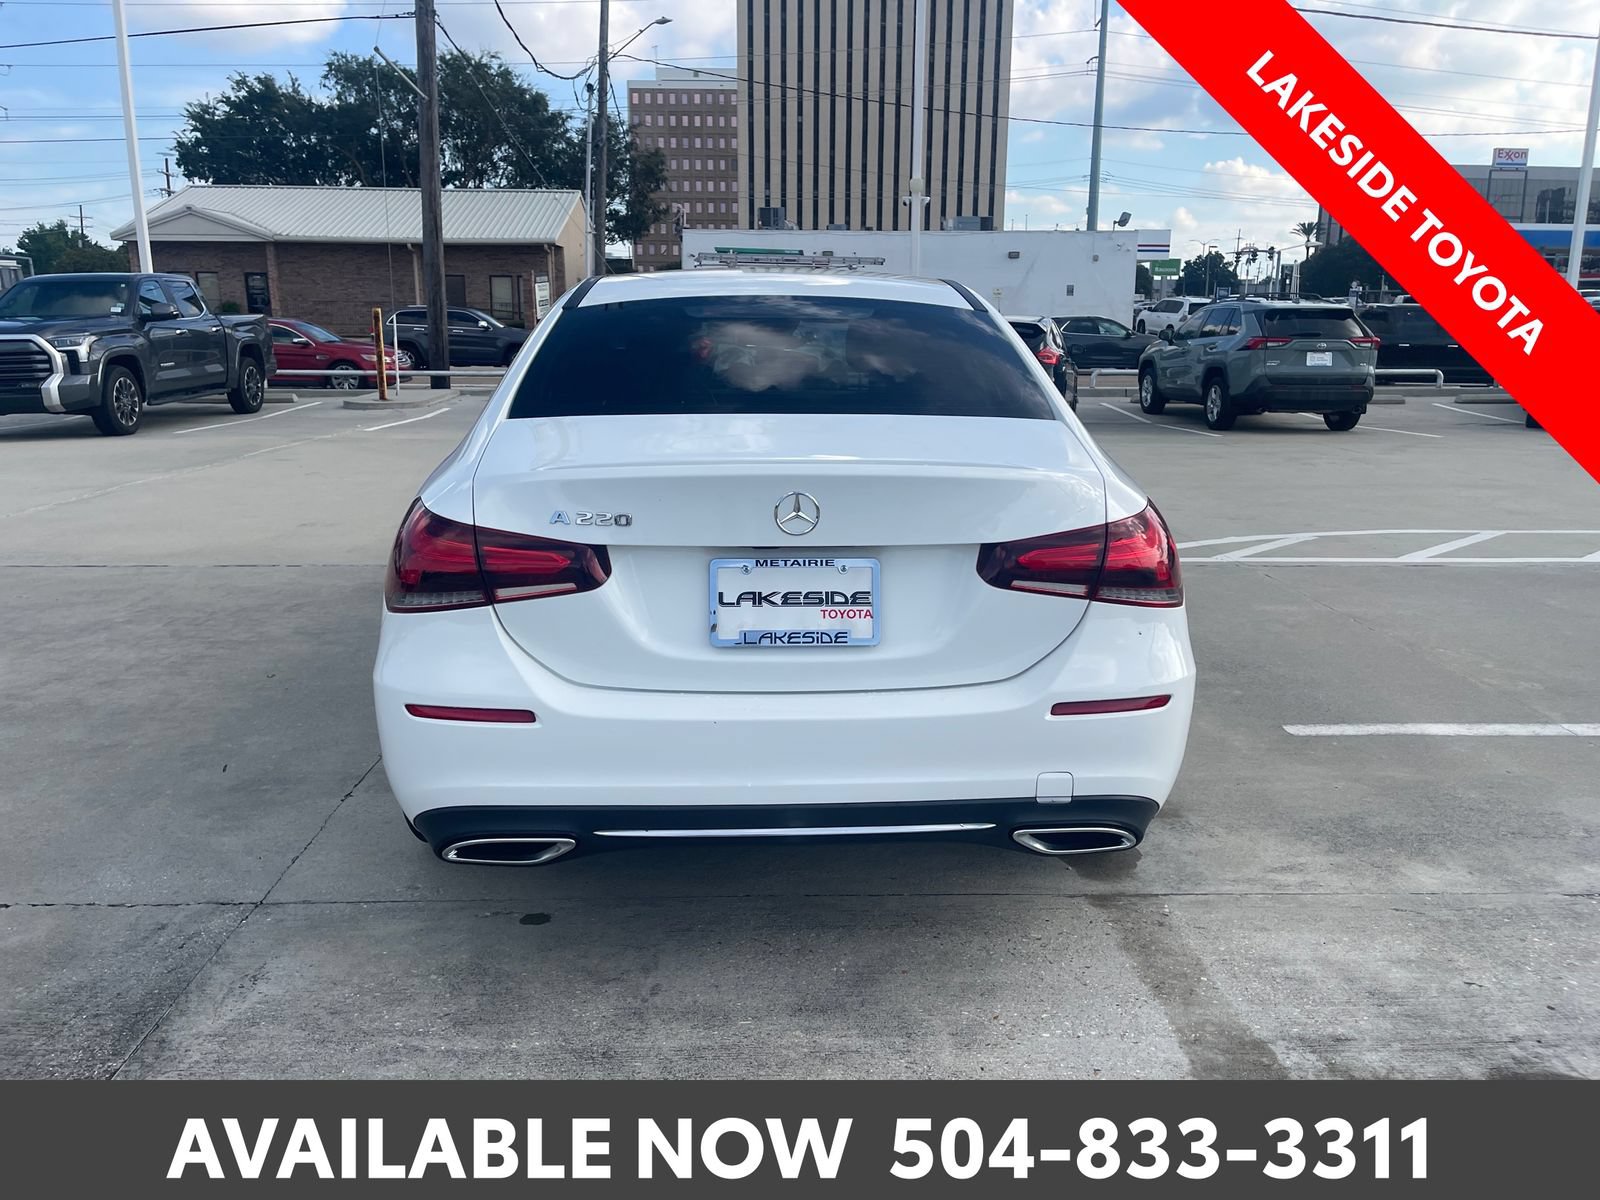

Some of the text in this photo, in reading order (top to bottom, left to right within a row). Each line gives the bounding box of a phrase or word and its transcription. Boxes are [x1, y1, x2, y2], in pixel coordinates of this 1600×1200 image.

[1497, 148, 1527, 162] Exxon
[550, 510, 633, 527] A 220
[755, 559, 836, 567] METAIRIE
[718, 591, 873, 608] LAKESIDE
[820, 609, 874, 620] TOYOTA
